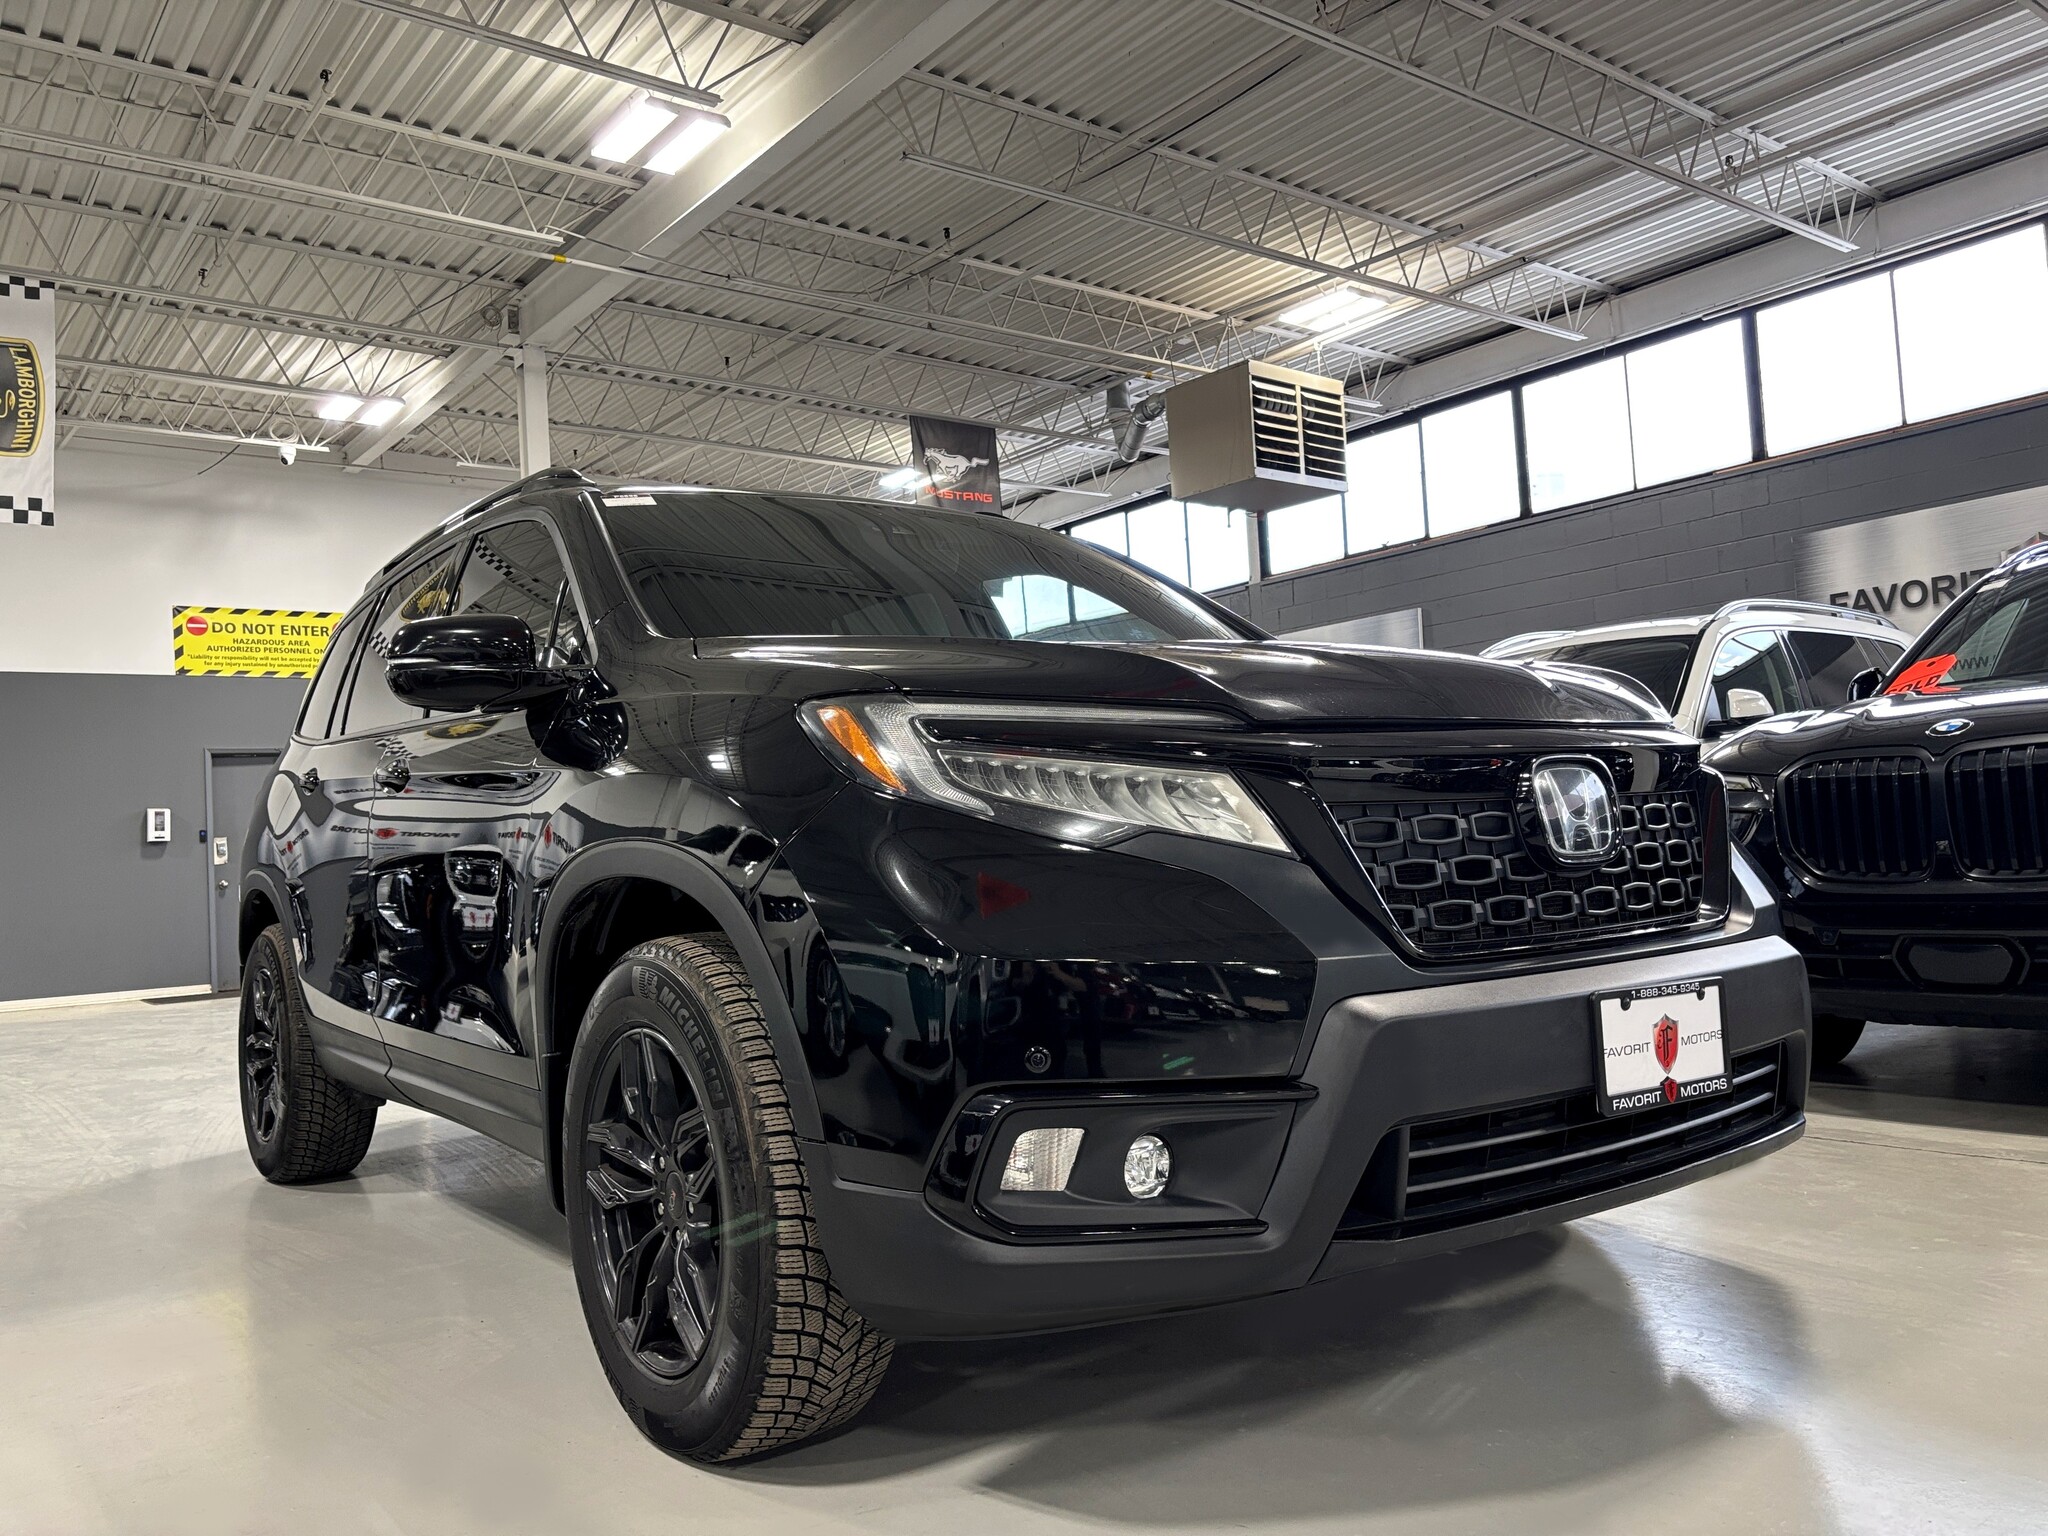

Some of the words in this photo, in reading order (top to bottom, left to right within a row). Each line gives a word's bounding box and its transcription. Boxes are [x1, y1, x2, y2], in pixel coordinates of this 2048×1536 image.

[8, 346, 36, 450] LAMBORGHINI
[925, 485, 993, 503] MUSTANG
[211, 622, 237, 634] DO
[242, 623, 276, 635] NOT
[280, 625, 330, 637] ENTER
[206, 645, 261, 654] AUTHORIZED
[263, 646, 312, 655] PERSONNEL
[232, 638, 286, 646] HAZARDOUS
[288, 639, 310, 647] AREA
[1631, 982, 1700, 998] 1-888-345-9345
[659, 986, 725, 1101] MICHELIN
[1603, 1042, 1651, 1059] FAVORIT
[1681, 1029, 1723, 1046] MOTORS
[1613, 1091, 1662, 1111] FAVORIT
[1680, 1078, 1728, 1098] MOTORS
